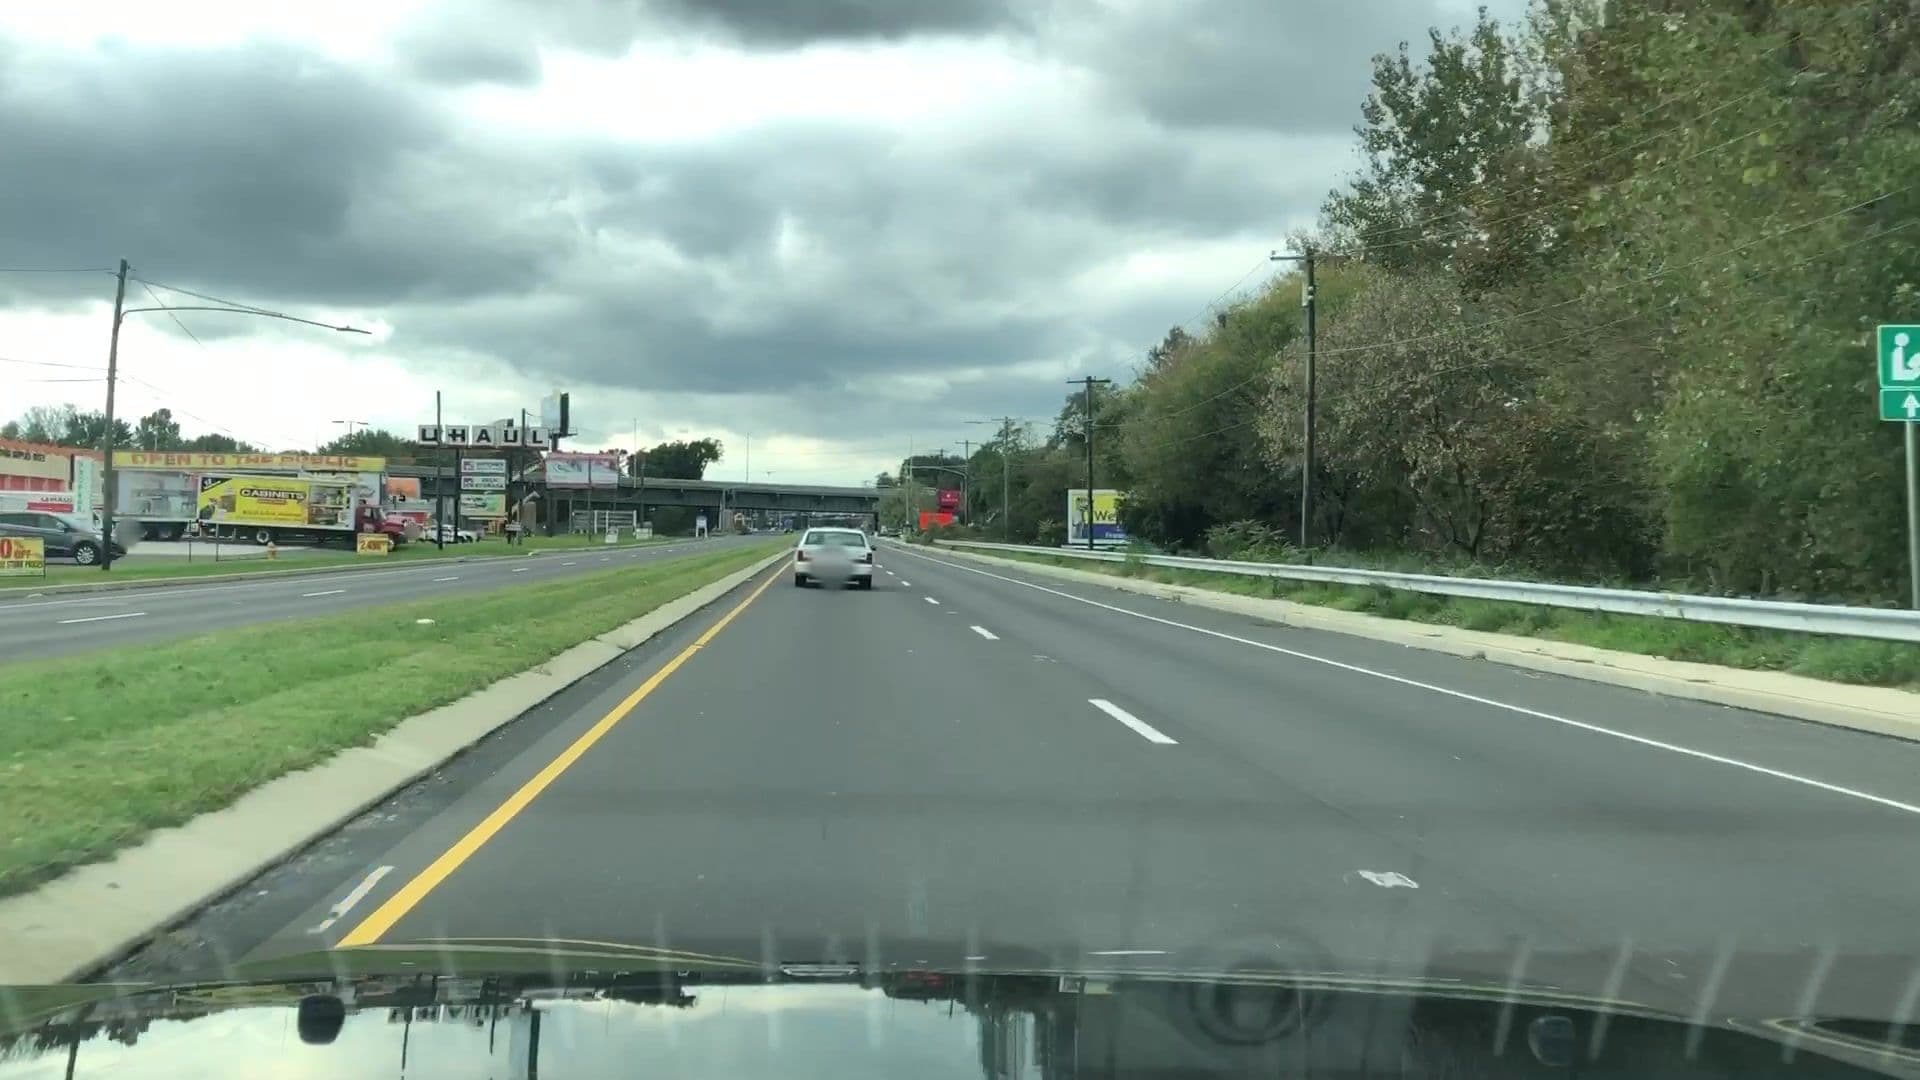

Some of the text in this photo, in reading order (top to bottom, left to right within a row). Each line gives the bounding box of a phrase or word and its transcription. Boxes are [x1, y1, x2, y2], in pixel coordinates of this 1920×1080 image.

[131, 454, 191, 466] OPEN
[200, 455, 225, 466] TO
[241, 488, 305, 500] CABINETS
